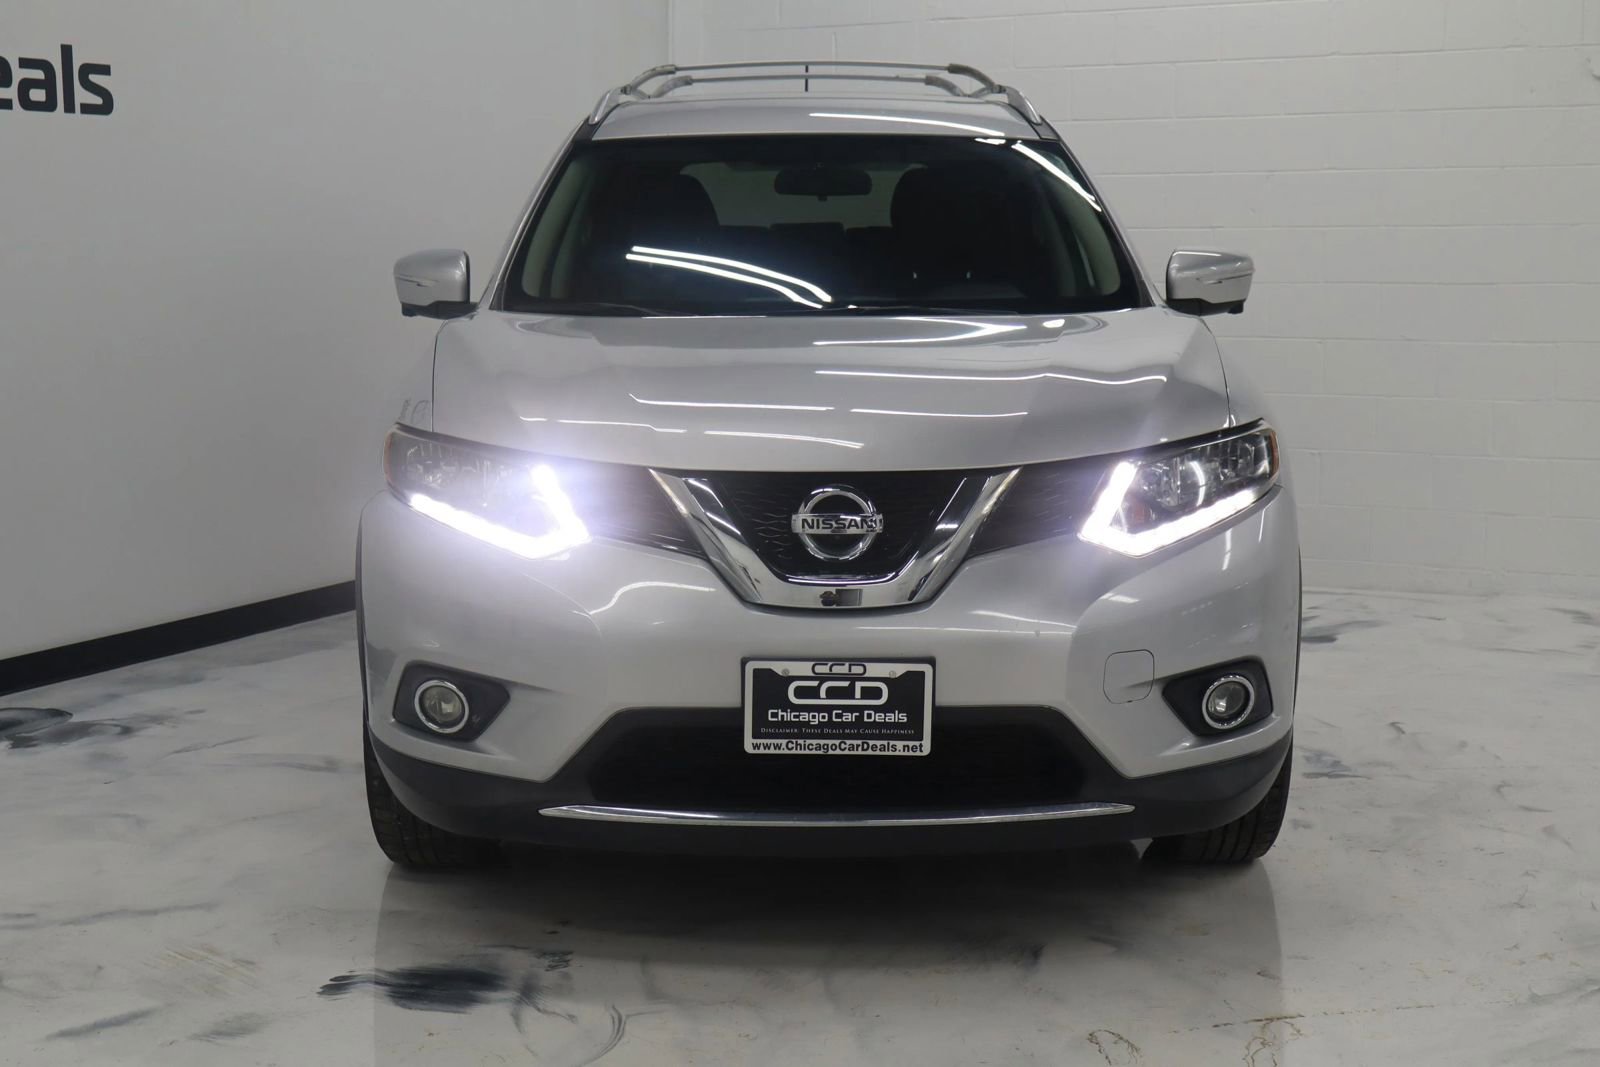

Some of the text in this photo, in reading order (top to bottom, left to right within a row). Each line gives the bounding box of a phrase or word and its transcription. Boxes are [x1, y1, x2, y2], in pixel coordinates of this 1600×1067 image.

[801, 517, 878, 530] NISSAN
[811, 662, 867, 676] CCD
[787, 680, 889, 706] CCD
[767, 709, 908, 725] Chicago Car Deals
[751, 740, 924, 754] www.ChicagoCarDeals.net
